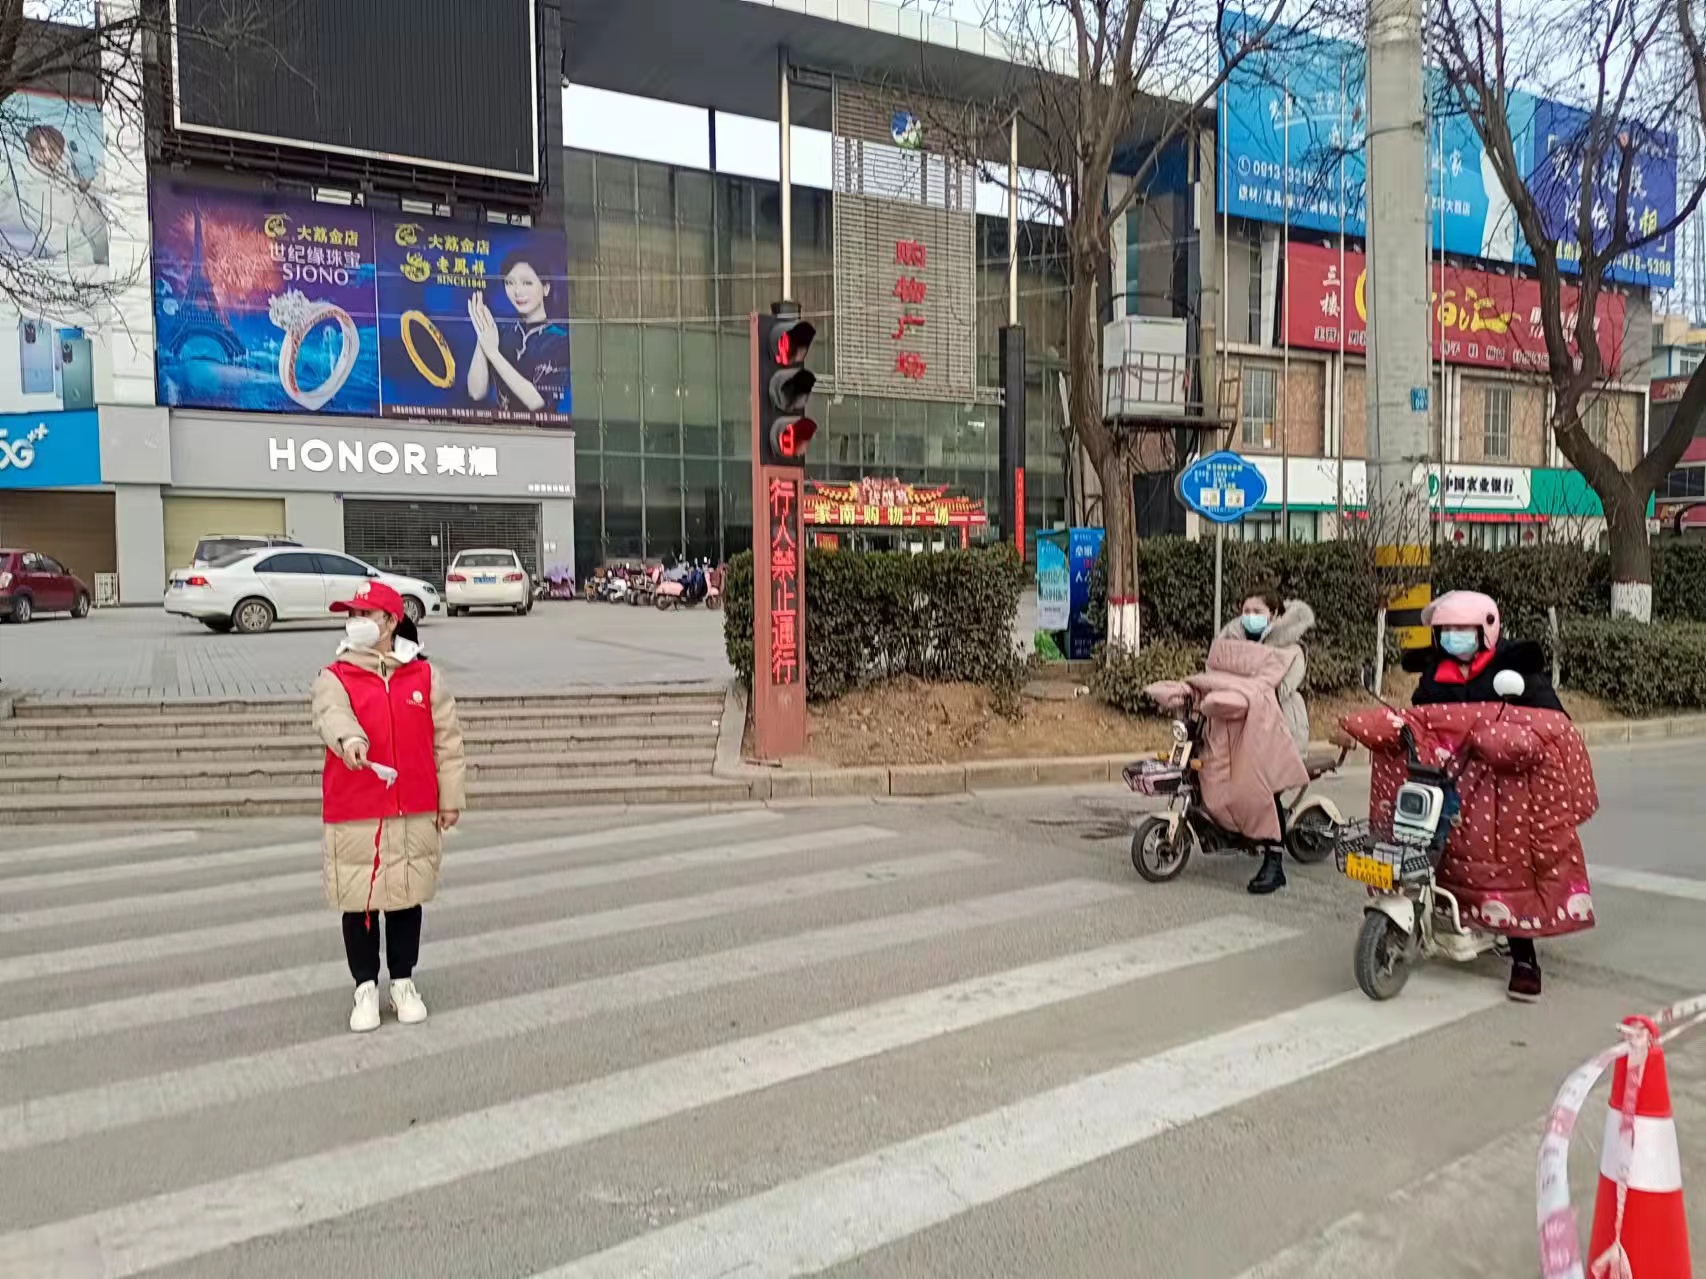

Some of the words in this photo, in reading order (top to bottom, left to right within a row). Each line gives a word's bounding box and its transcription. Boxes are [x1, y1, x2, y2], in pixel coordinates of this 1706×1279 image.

[270, 242, 361, 270] 世纪缘珠宝
[891, 240, 927, 383] 购物广场
[268, 437, 429, 475] HONOR
[436, 444, 498, 477] 荣耀
[1445, 475, 1514, 494] 中国农业银行
[770, 477, 797, 685] 行人禁止通行
